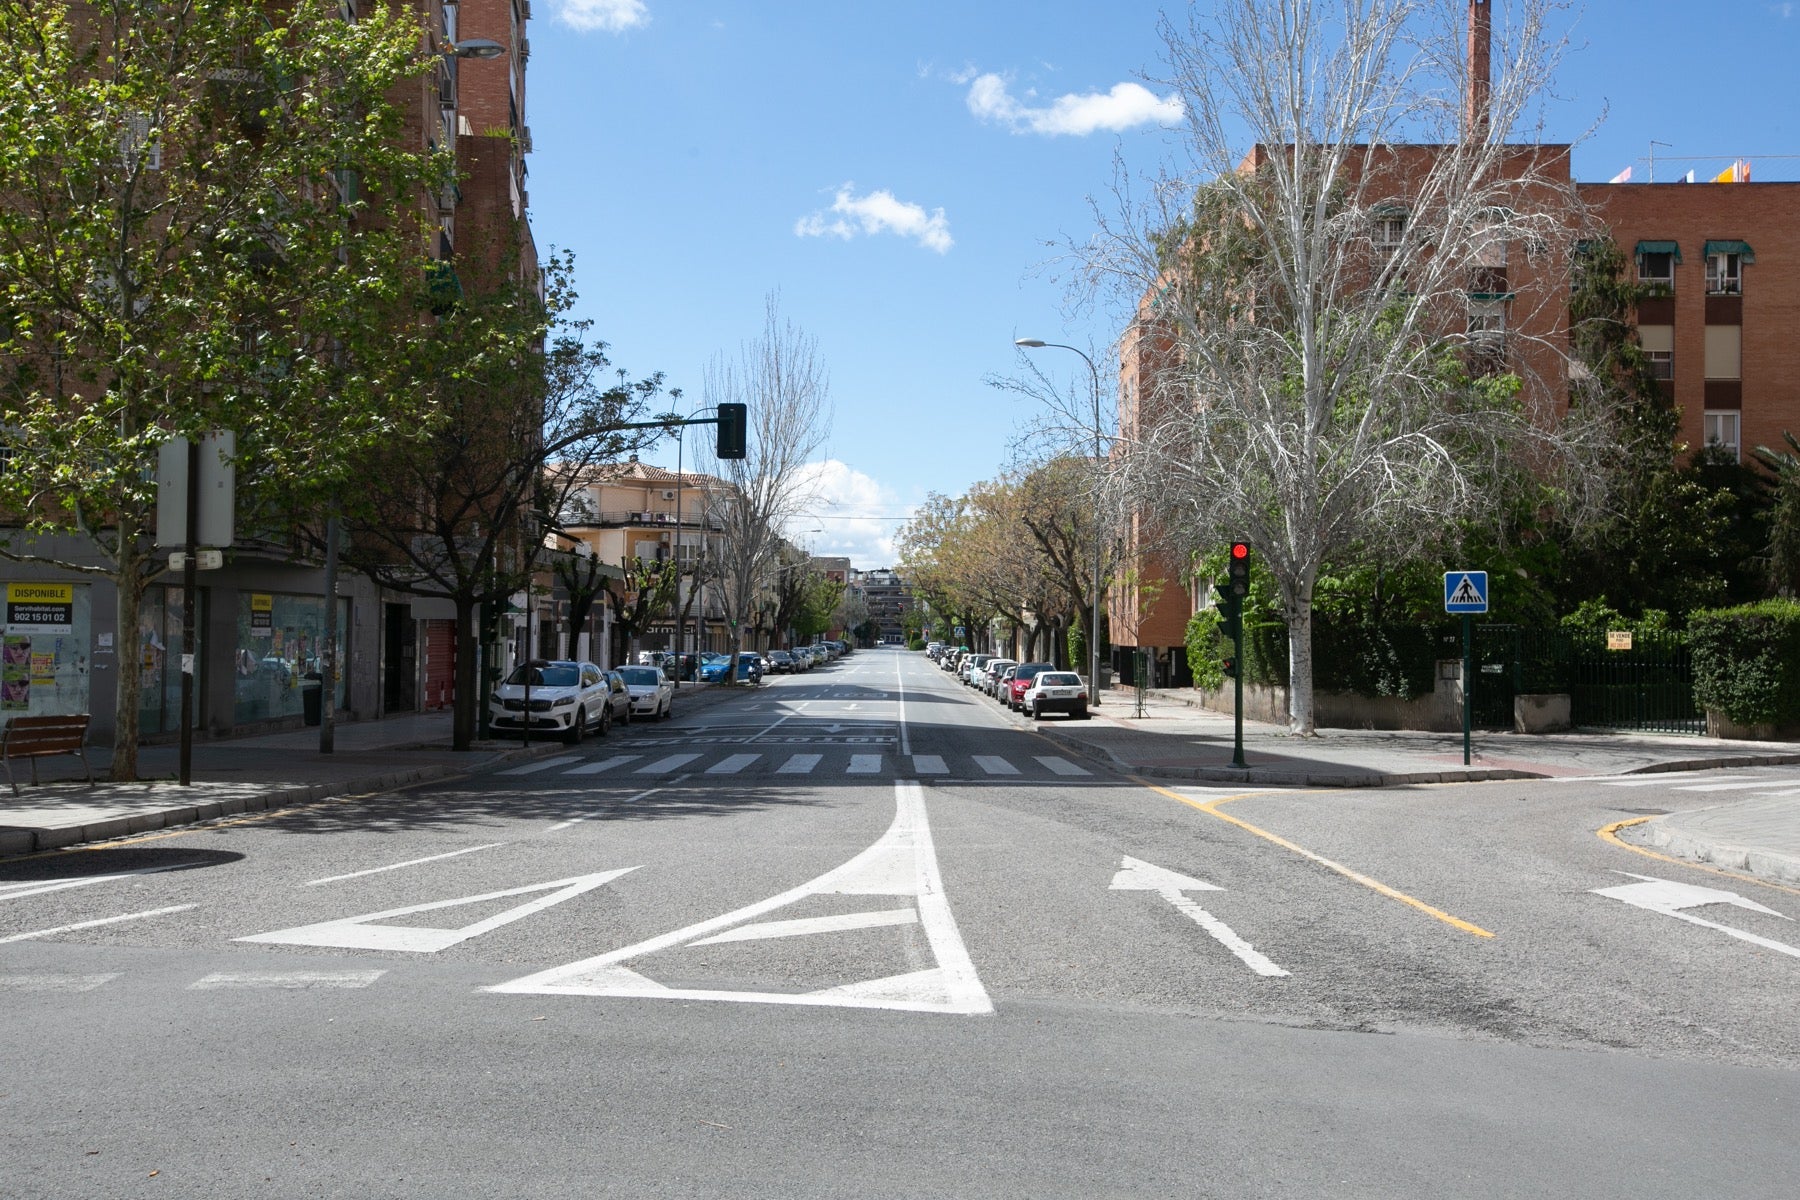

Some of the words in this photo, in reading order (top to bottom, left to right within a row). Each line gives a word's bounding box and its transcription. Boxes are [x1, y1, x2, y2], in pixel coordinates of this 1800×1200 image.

[15, 589, 66, 598] DISPONIBLE
[14, 613, 31, 621] 902
[32, 613, 42, 621] 15
[42, 613, 52, 621] 01
[53, 613, 65, 622] 02
